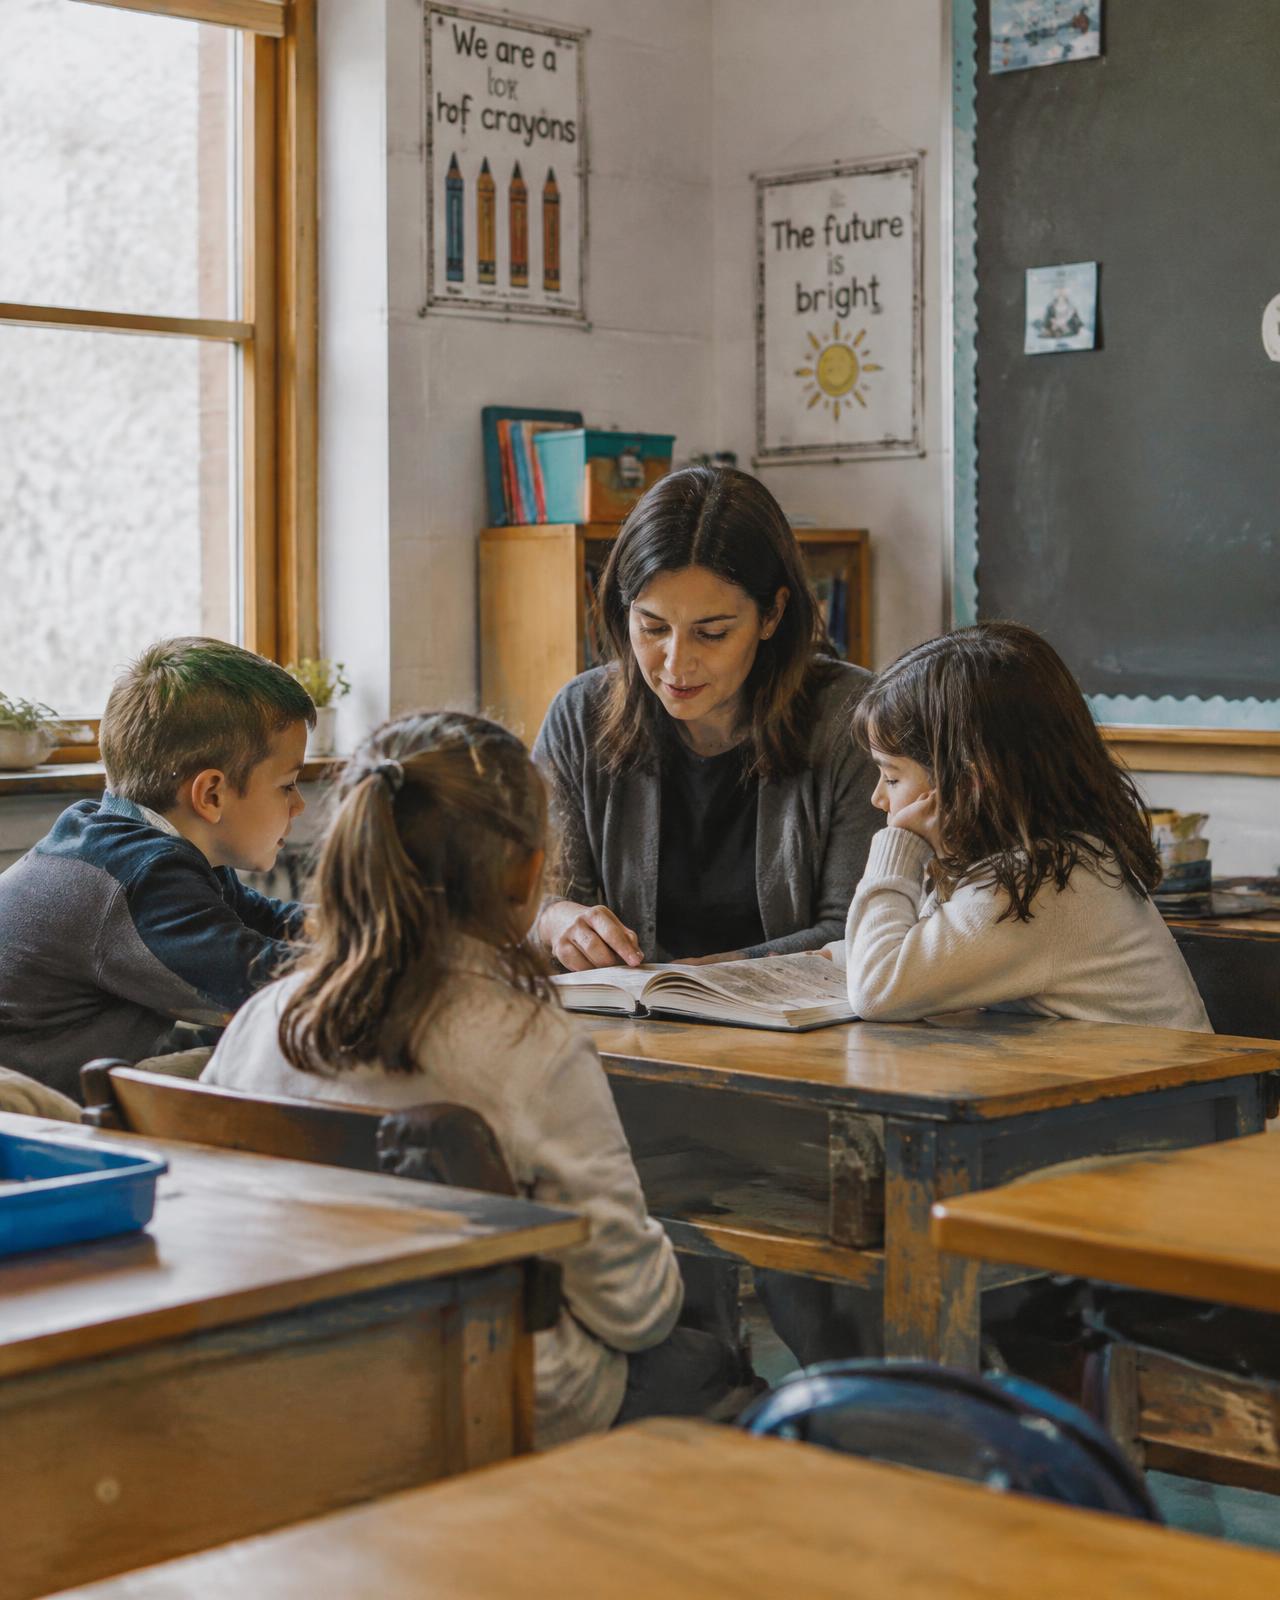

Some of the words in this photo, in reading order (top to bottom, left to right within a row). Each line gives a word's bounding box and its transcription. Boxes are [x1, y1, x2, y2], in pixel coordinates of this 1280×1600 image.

[452, 23, 487, 59] We
[495, 41, 535, 69] are
[543, 50, 557, 72] a
[481, 107, 576, 147] crayons
[771, 219, 815, 251] The
[823, 211, 903, 246] future
[827, 252, 845, 275] is
[795, 274, 880, 319] bright
